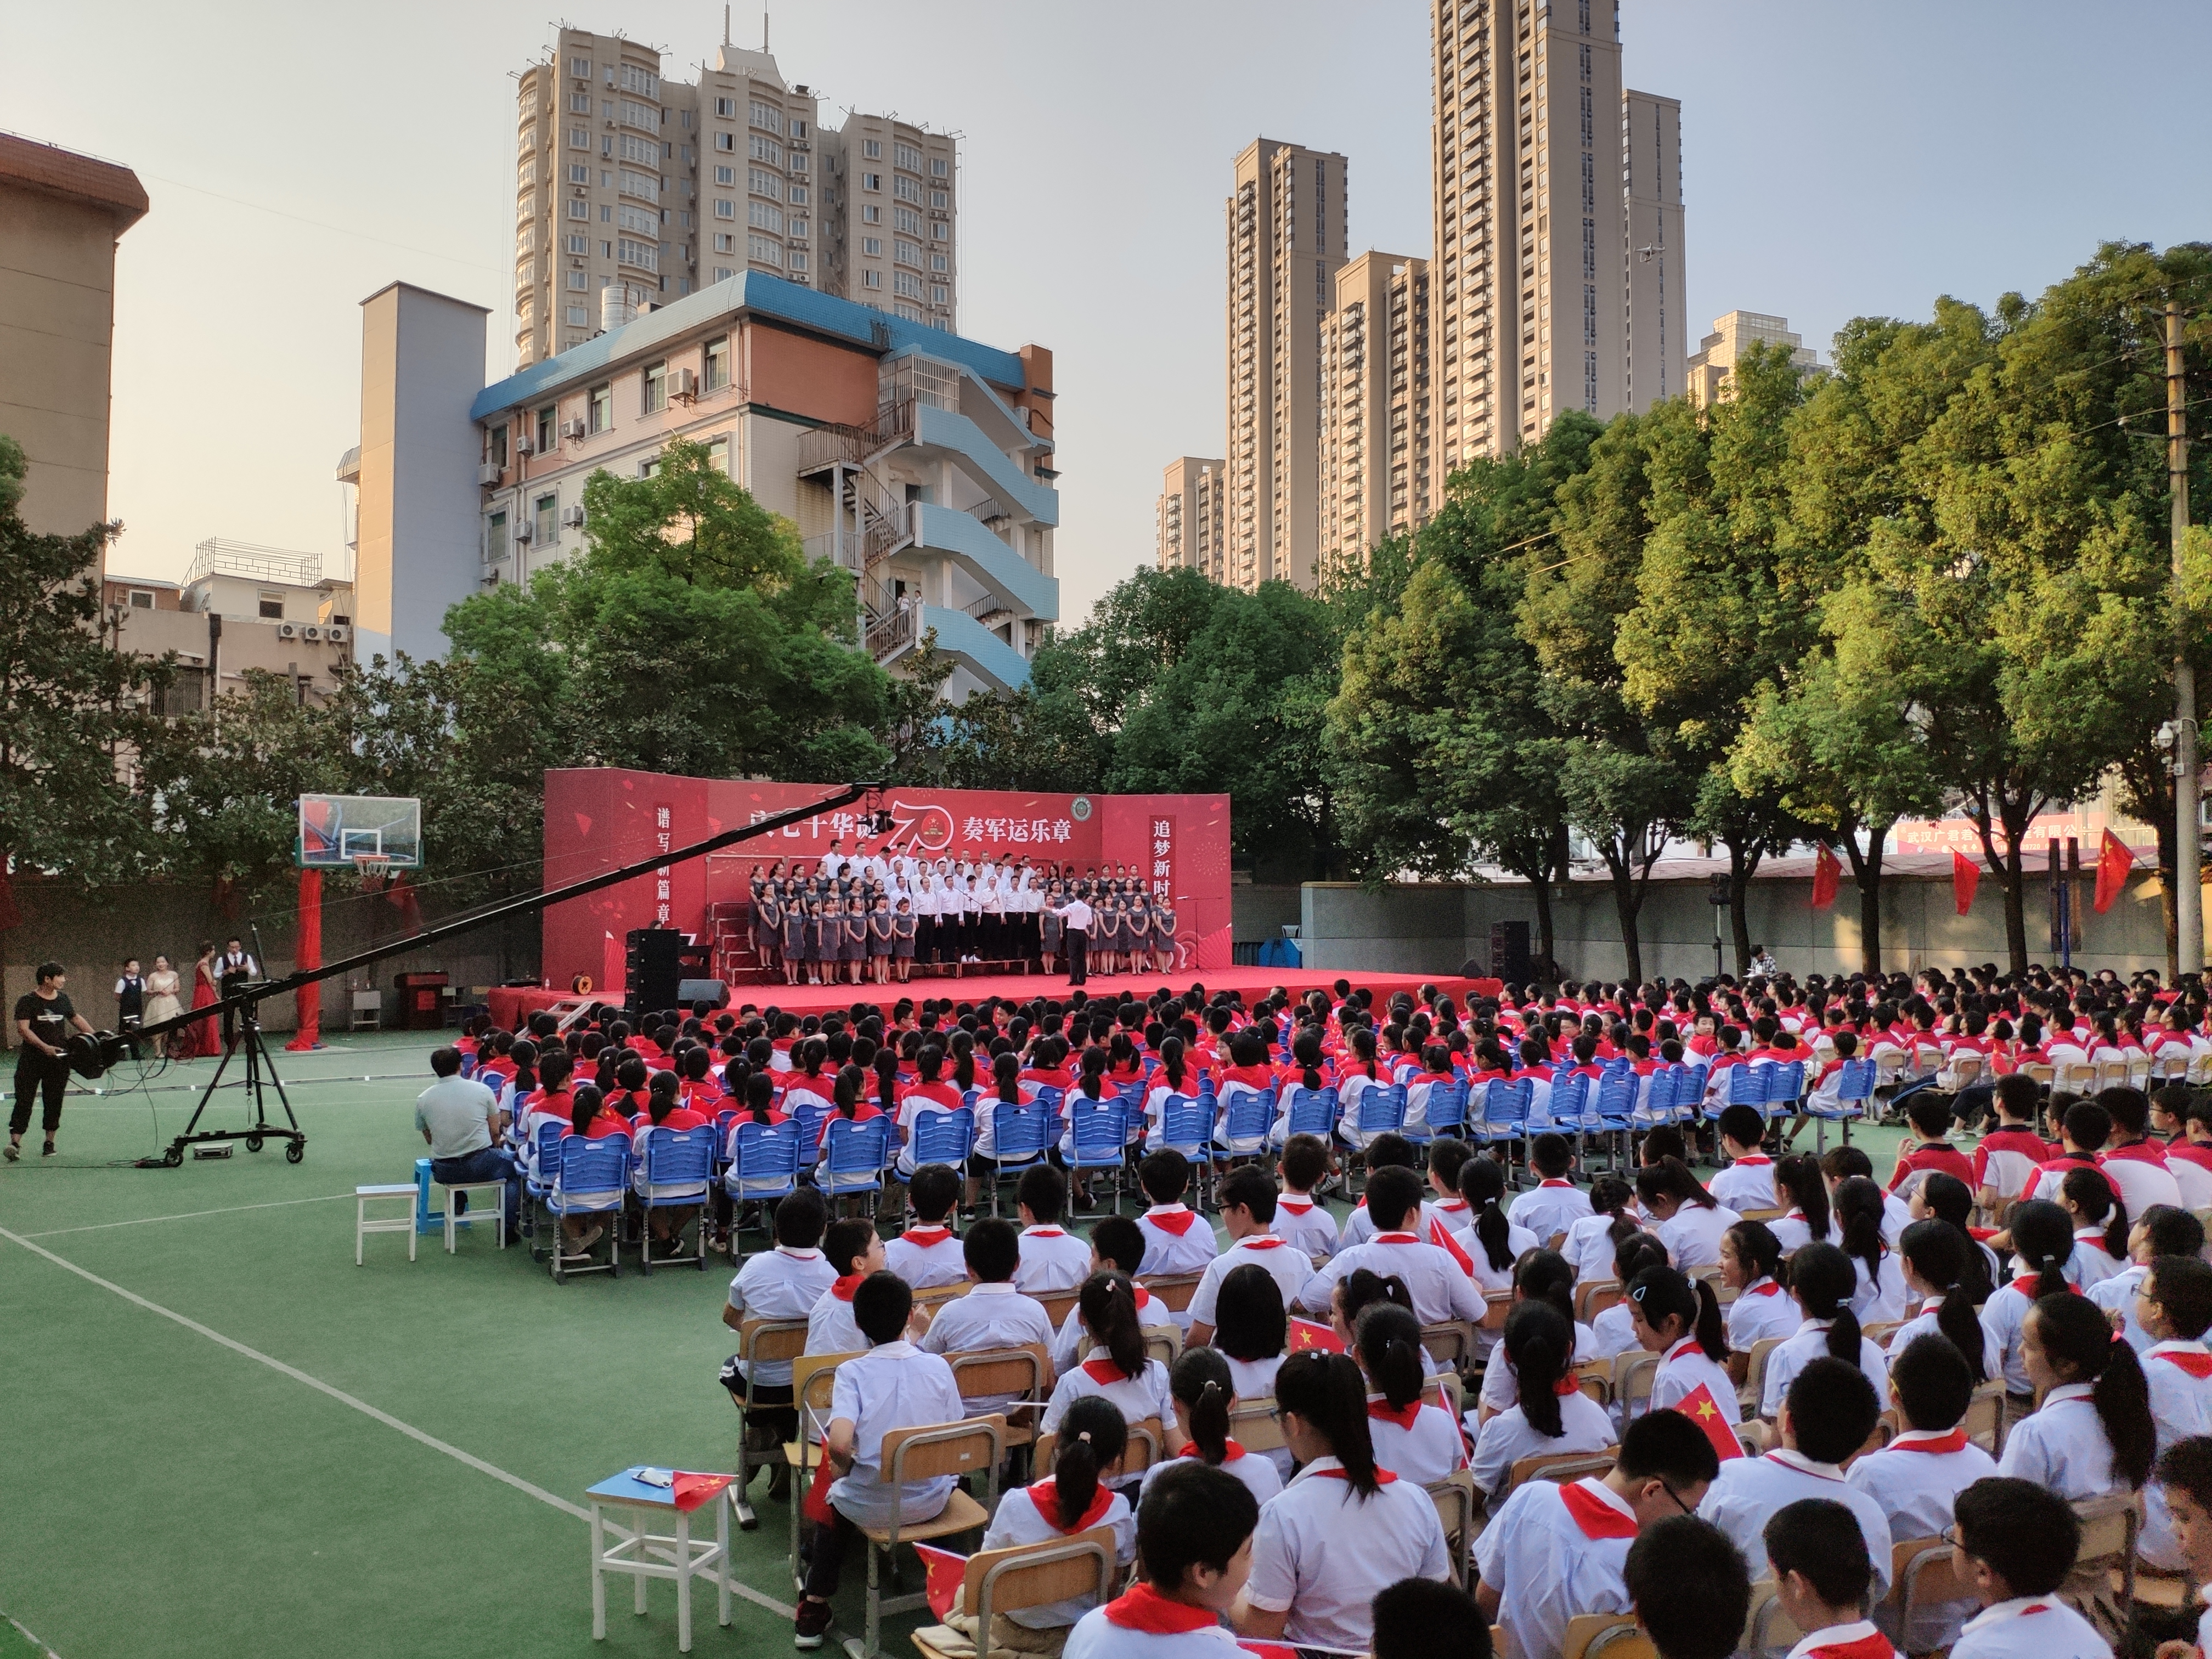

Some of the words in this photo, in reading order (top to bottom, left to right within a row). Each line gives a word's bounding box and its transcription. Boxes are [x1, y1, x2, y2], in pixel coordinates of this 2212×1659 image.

[962, 816, 1072, 843] 奏军运乐章
[1153, 820, 1171, 897] 追梦新时
